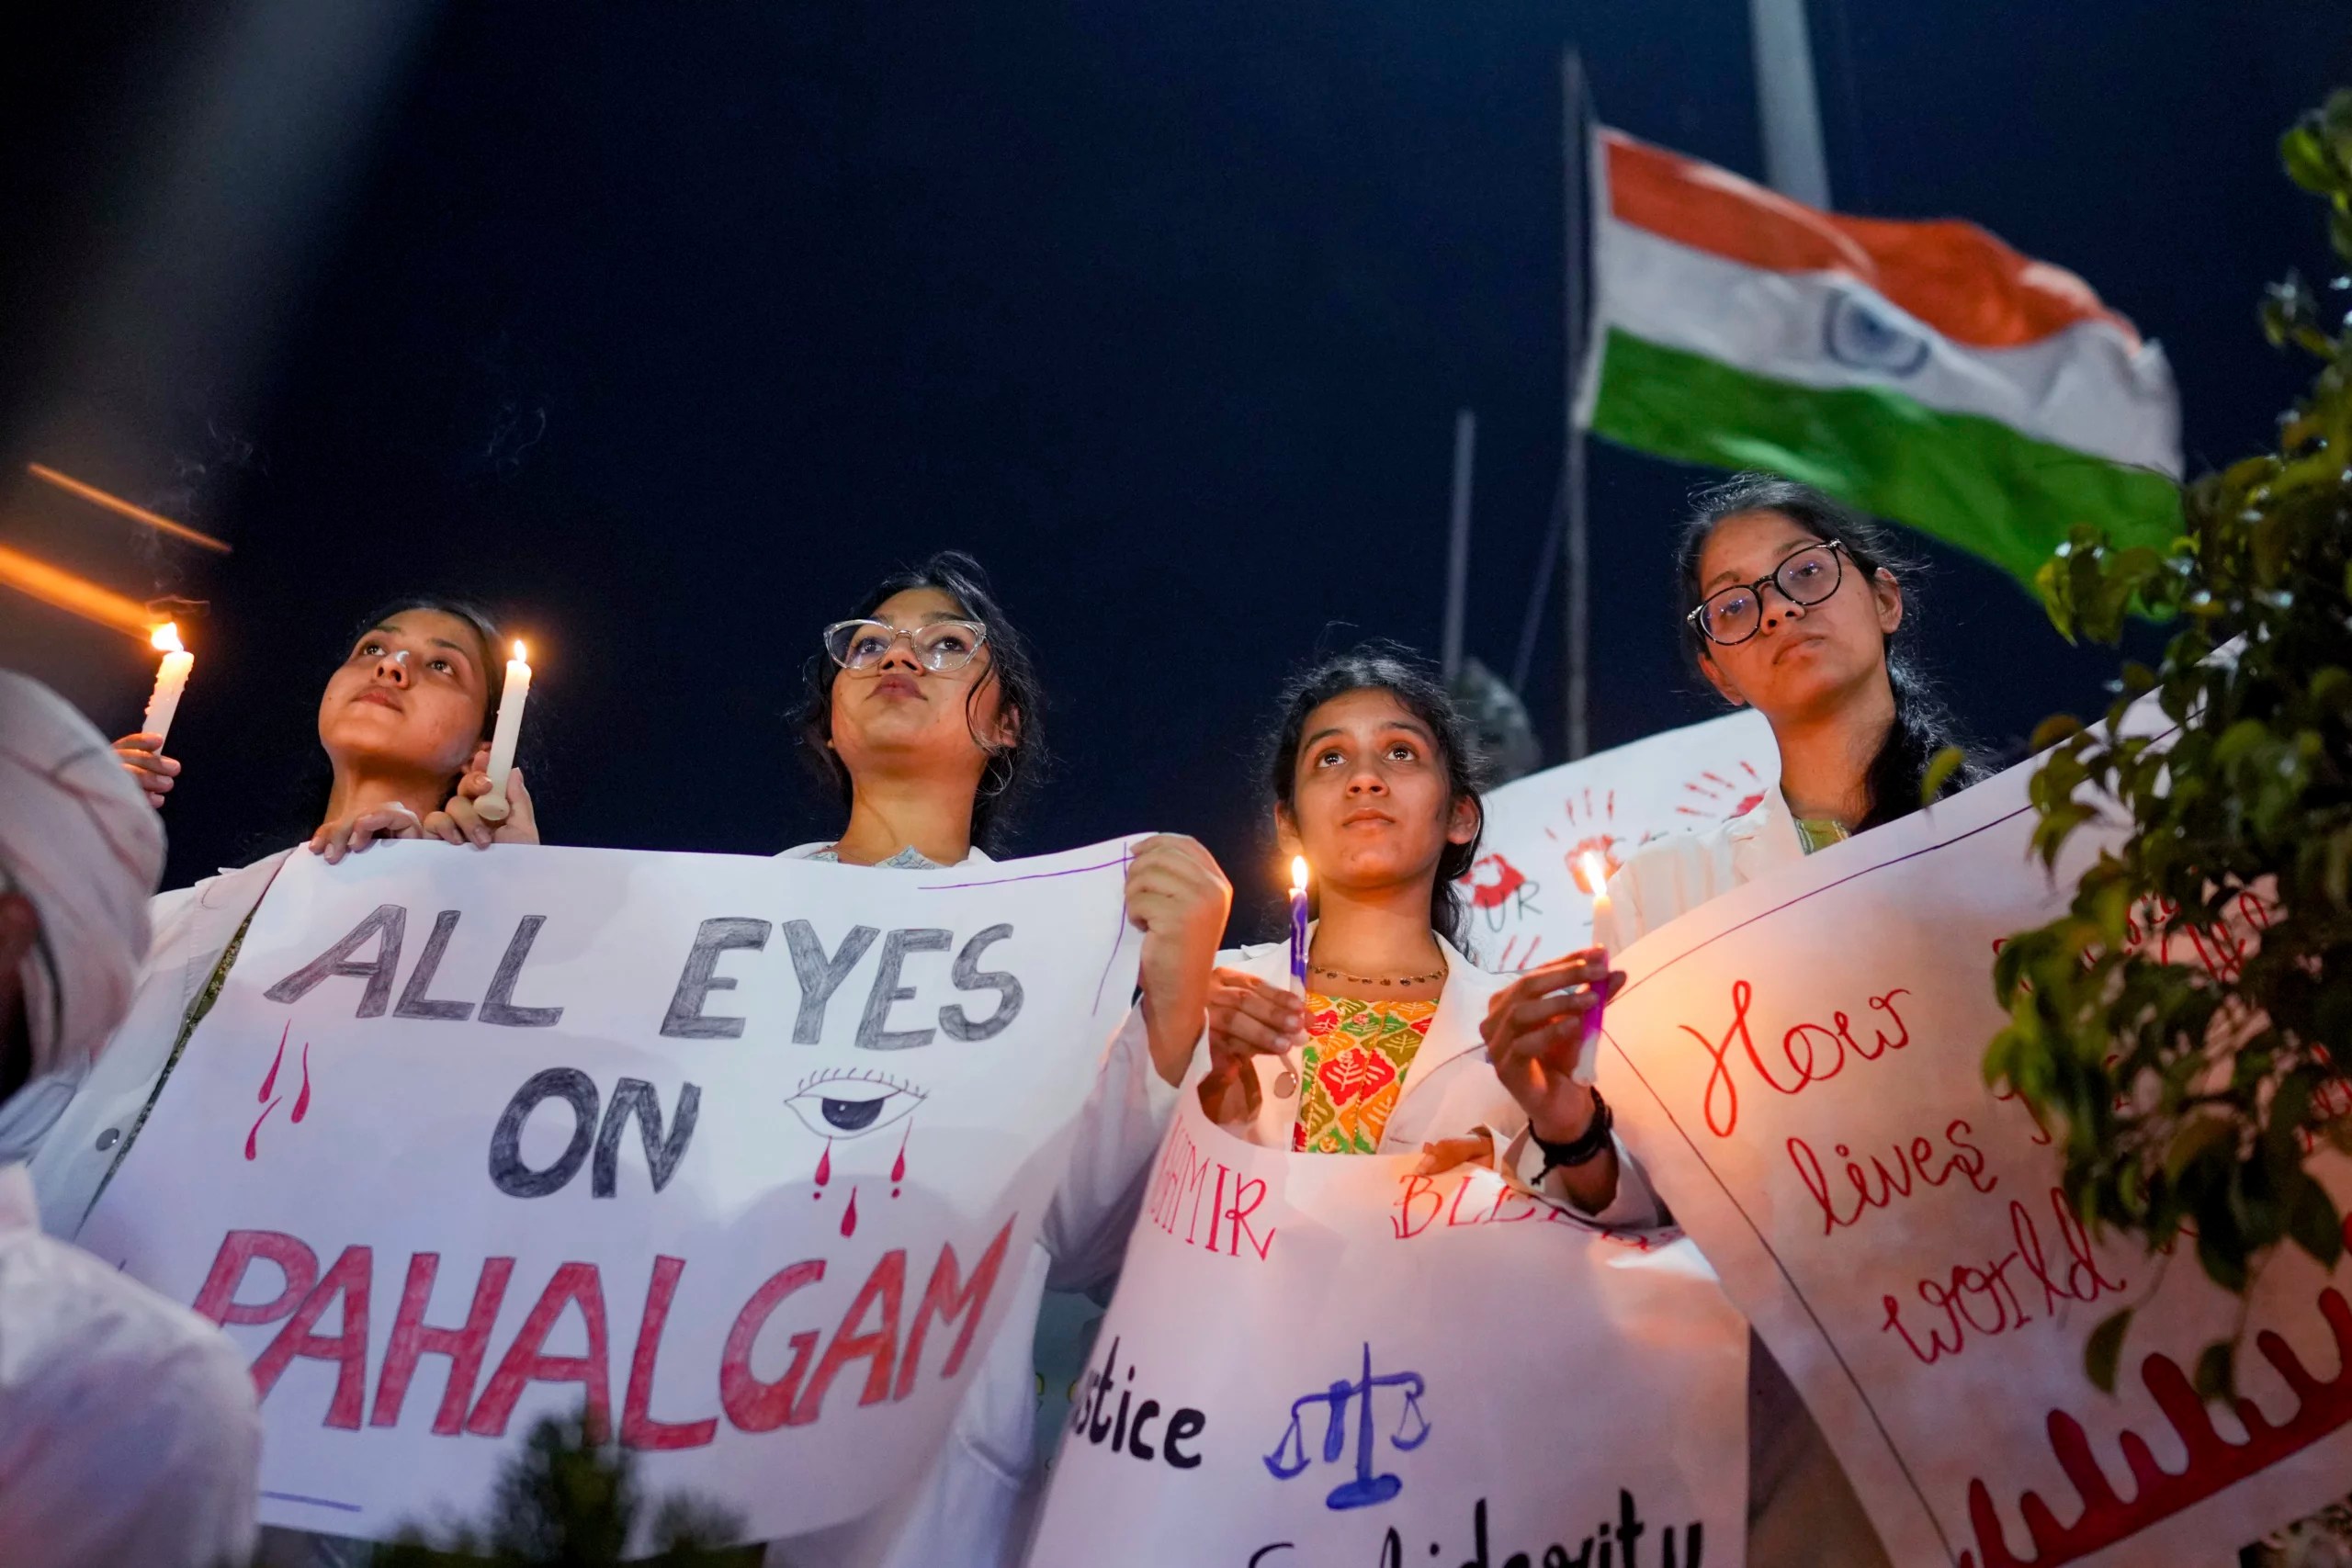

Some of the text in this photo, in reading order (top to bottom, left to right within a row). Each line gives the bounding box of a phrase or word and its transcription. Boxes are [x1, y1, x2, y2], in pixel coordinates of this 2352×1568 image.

[264, 904, 1025, 1052] ALL EYES
[488, 1066, 702, 1199] ON
[1678, 979, 1912, 1138] How
[1786, 1119, 1998, 1236] lives
[191, 1213, 1016, 1450] PAHALGAM
[1881, 1186, 2127, 1365] world
